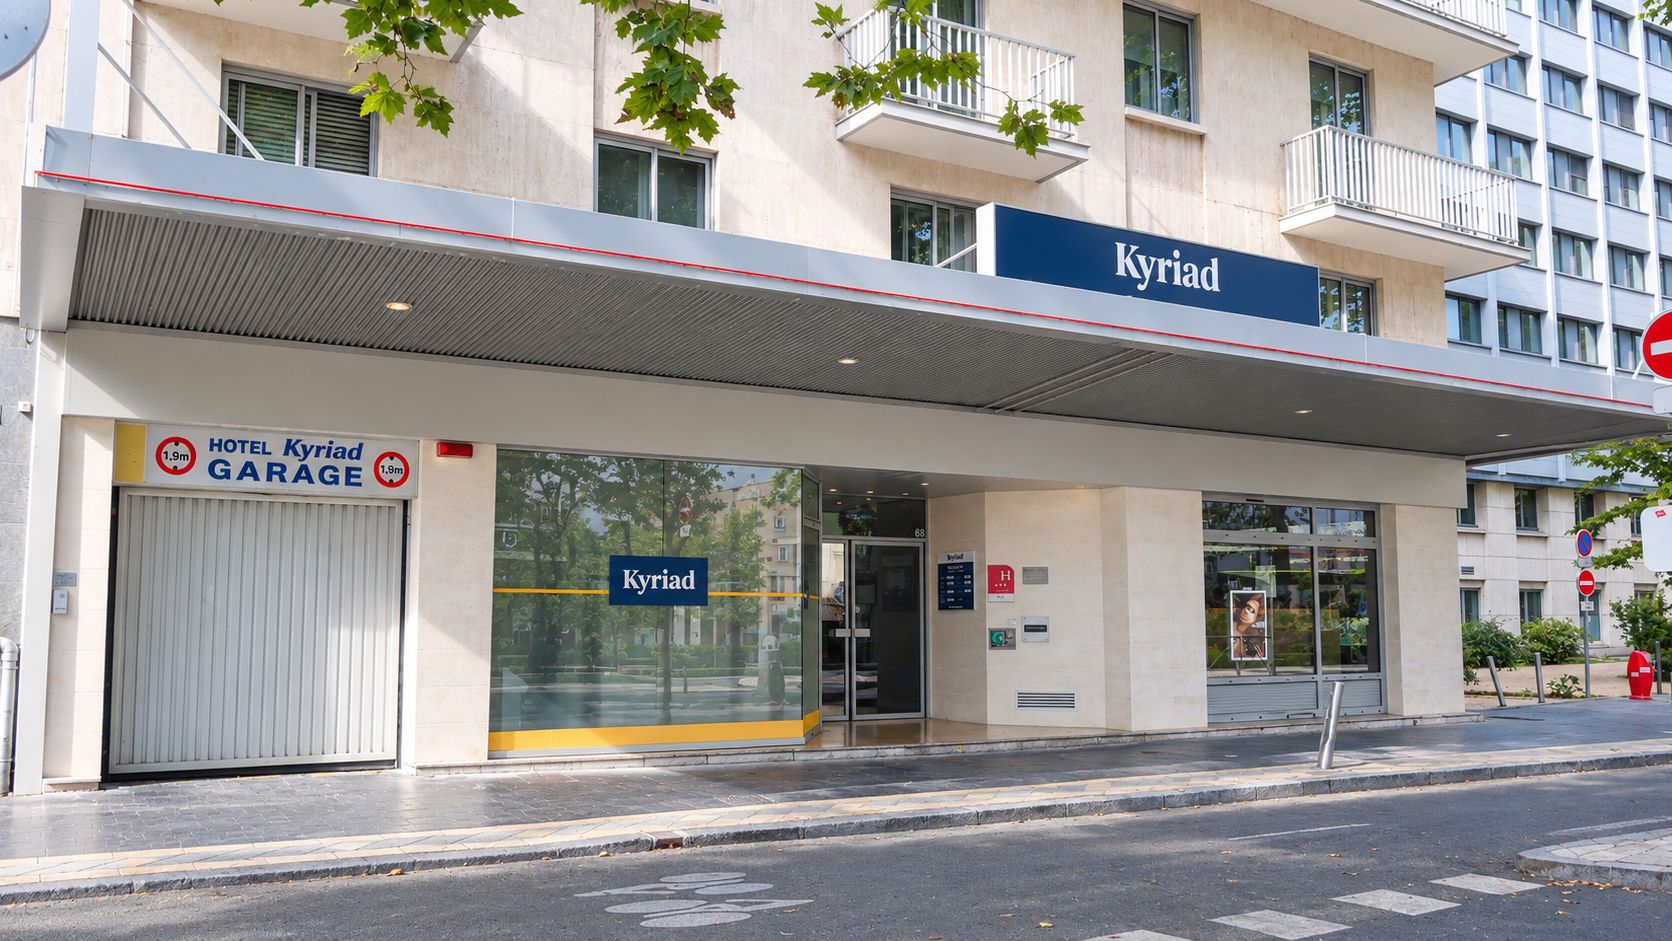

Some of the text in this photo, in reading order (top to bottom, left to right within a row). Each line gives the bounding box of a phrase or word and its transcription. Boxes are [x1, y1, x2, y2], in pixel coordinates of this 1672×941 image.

[1115, 241, 1221, 292] Kyriad
[209, 438, 364, 462] HOTEL Kyriad
[208, 458, 363, 487] GARAGE
[622, 568, 696, 596] Kyriad
[1001, 570, 1011, 581] H
